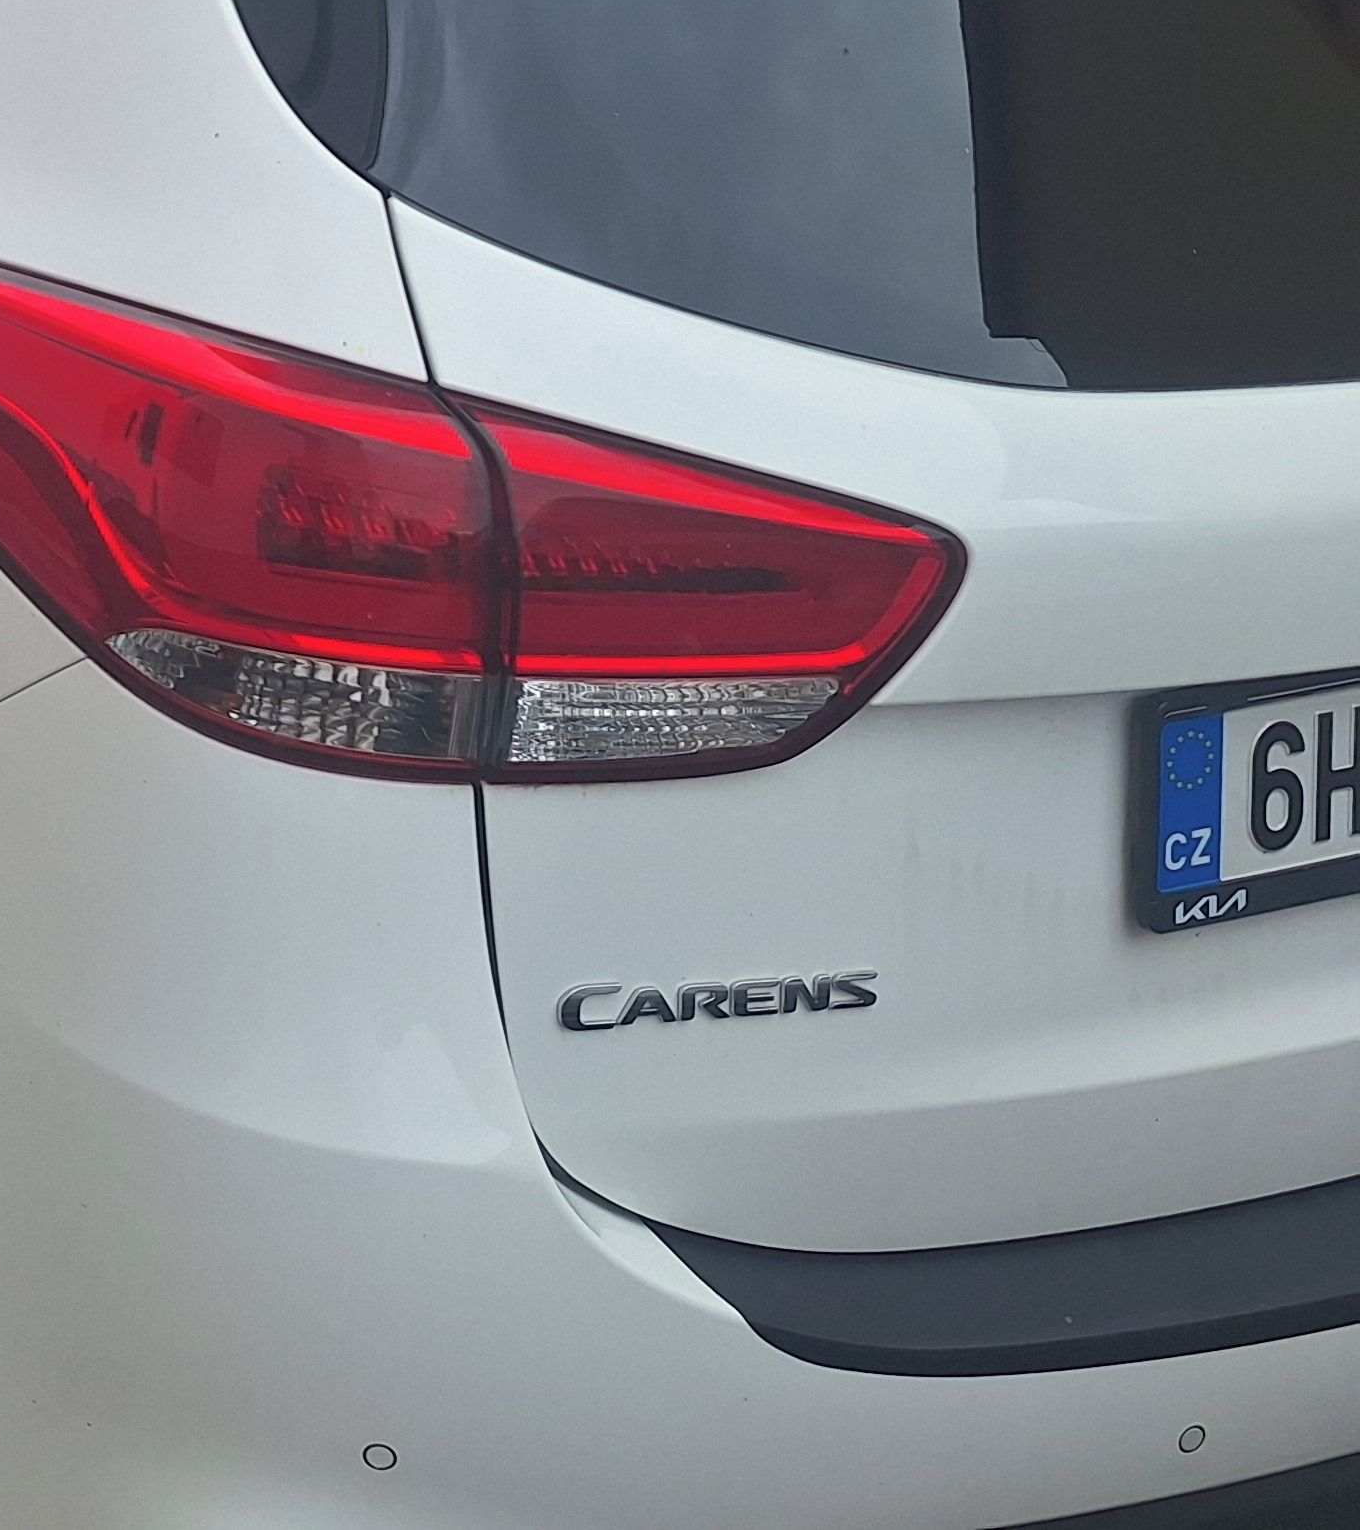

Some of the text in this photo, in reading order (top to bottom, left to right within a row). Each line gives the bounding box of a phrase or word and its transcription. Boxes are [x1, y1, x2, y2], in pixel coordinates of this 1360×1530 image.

[1250, 706, 1360, 852] 6H
[1164, 826, 1212, 871] CZ
[1175, 887, 1248, 925] KIA
[556, 969, 879, 1032] CARENS
